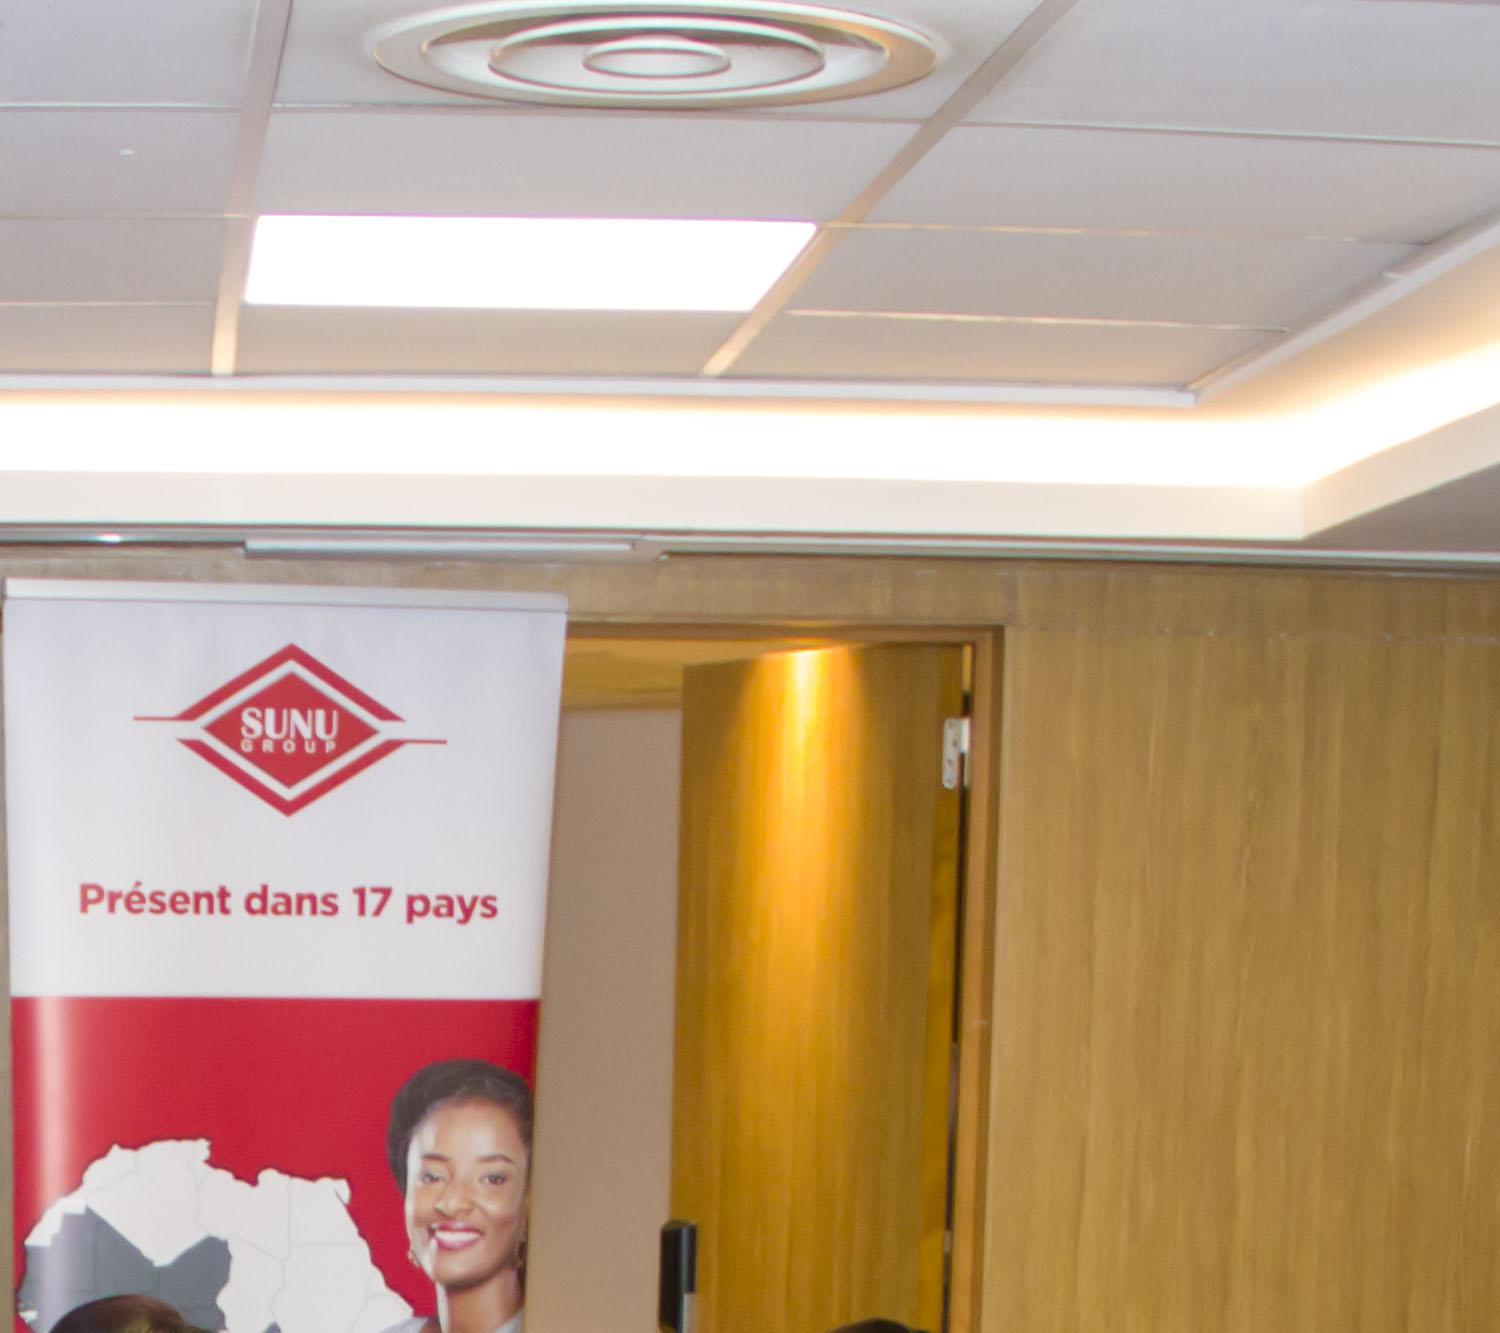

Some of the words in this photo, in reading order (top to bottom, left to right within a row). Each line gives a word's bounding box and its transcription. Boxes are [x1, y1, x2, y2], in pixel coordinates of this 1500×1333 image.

[240, 706, 339, 740] SUNU
[240, 740, 338, 755] GROUP
[79, 881, 231, 916] Présent
[244, 884, 339, 917] dans
[352, 886, 393, 917] 17
[406, 893, 498, 925] pays
